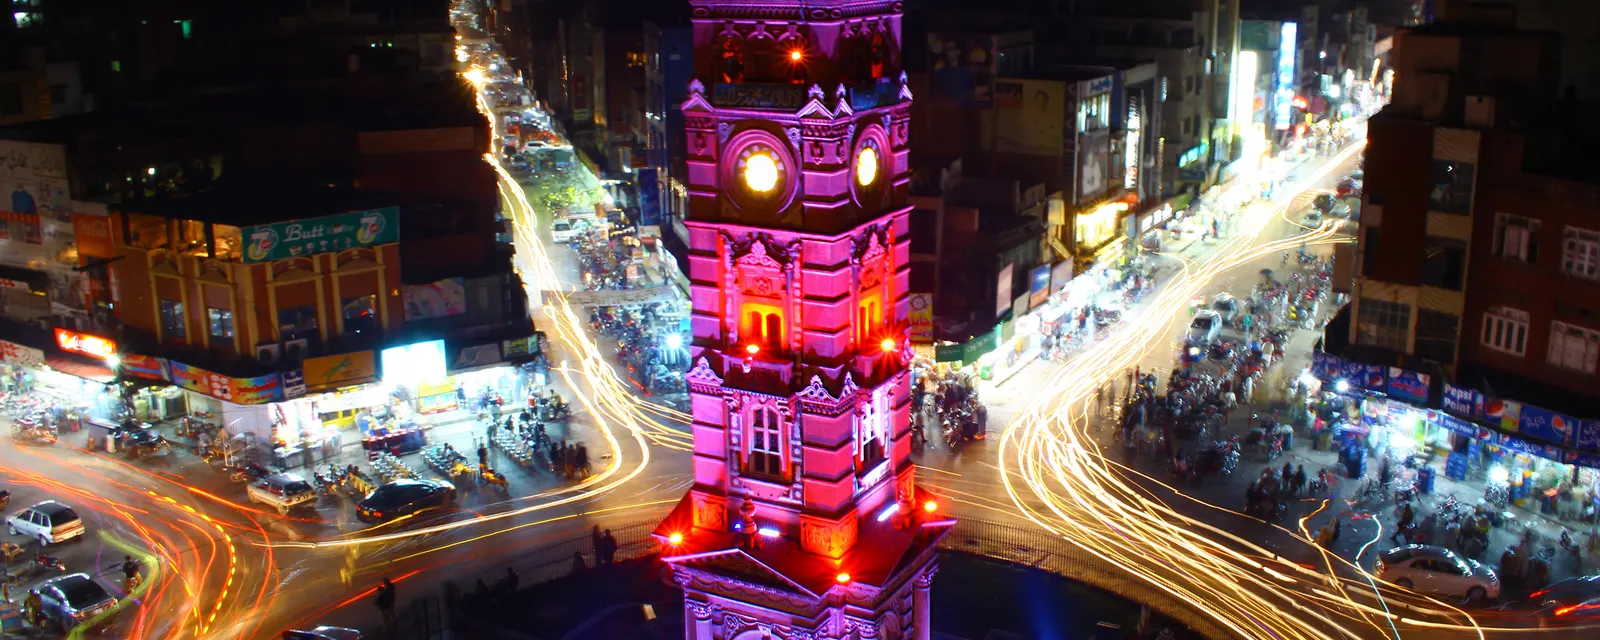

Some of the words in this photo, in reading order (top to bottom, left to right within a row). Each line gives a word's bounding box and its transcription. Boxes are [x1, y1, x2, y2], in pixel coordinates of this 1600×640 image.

[283, 224, 325, 242] Butt
[1444, 383, 1473, 401] Pepsi
[1443, 397, 1471, 414] Point
